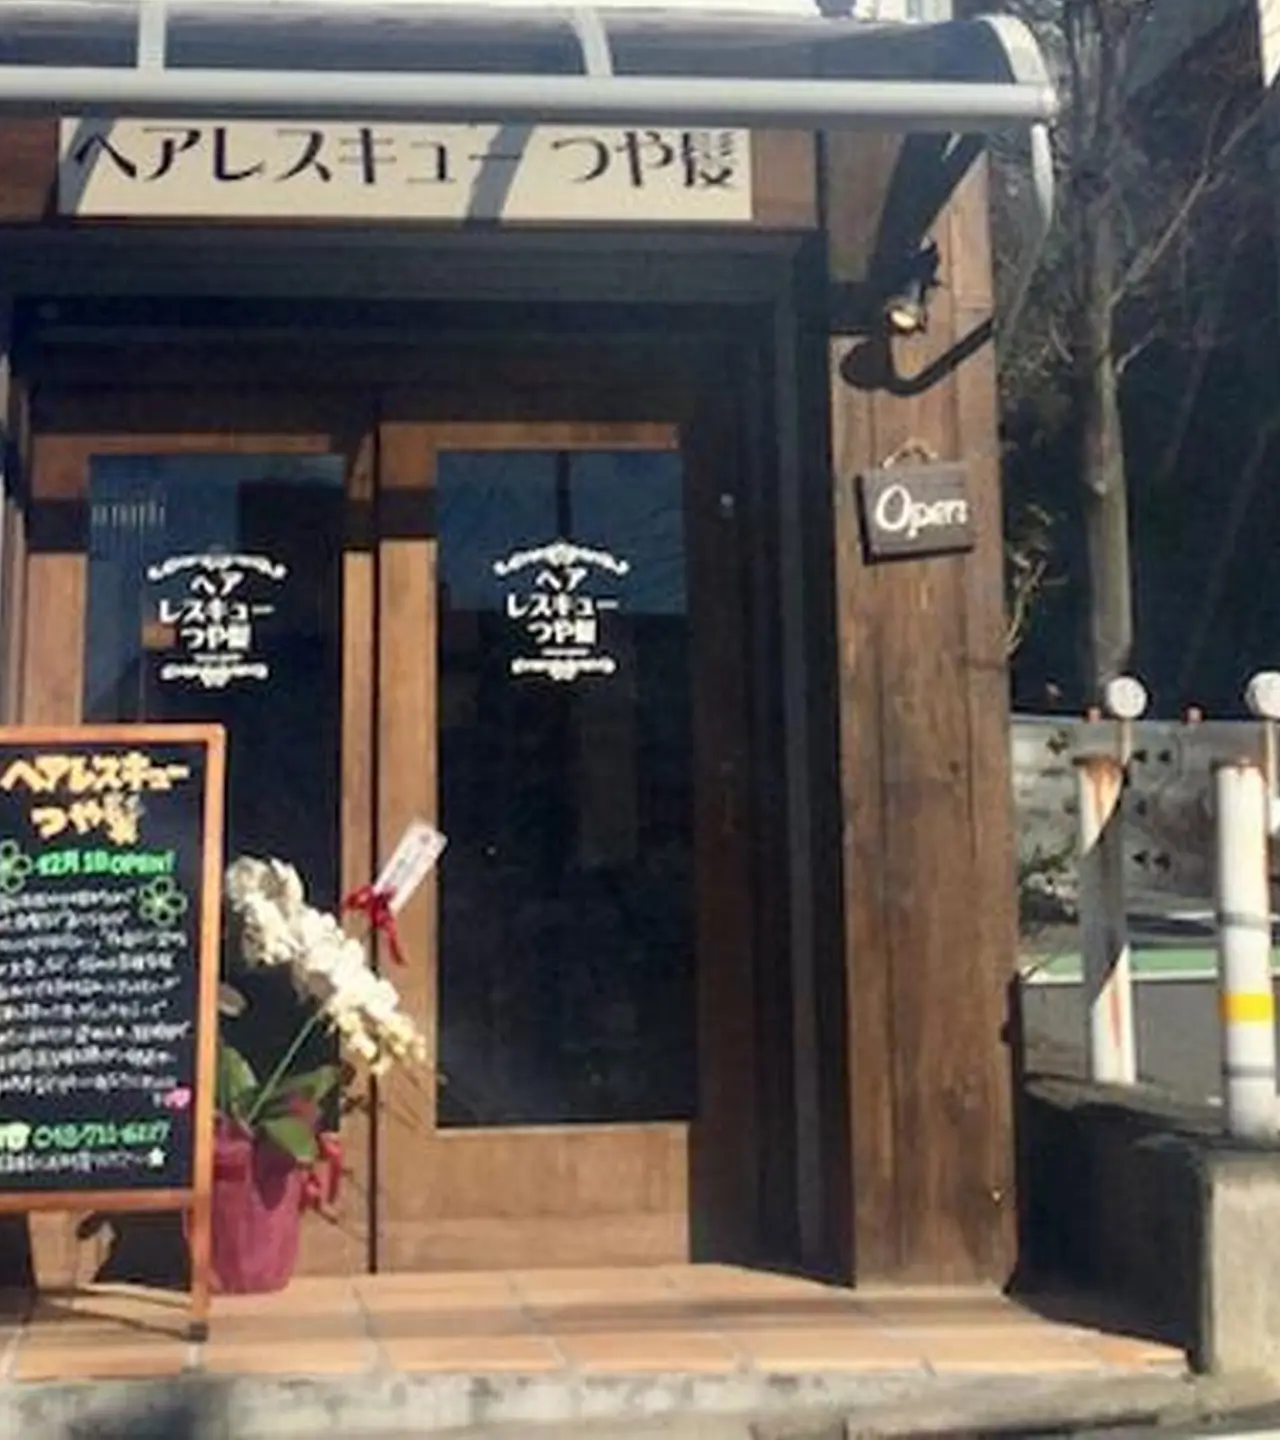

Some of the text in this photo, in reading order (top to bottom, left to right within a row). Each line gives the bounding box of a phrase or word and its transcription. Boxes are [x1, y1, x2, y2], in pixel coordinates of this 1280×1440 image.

[74, 125, 522, 185] ヘアレスキュー
[876, 484, 968, 540] Open
